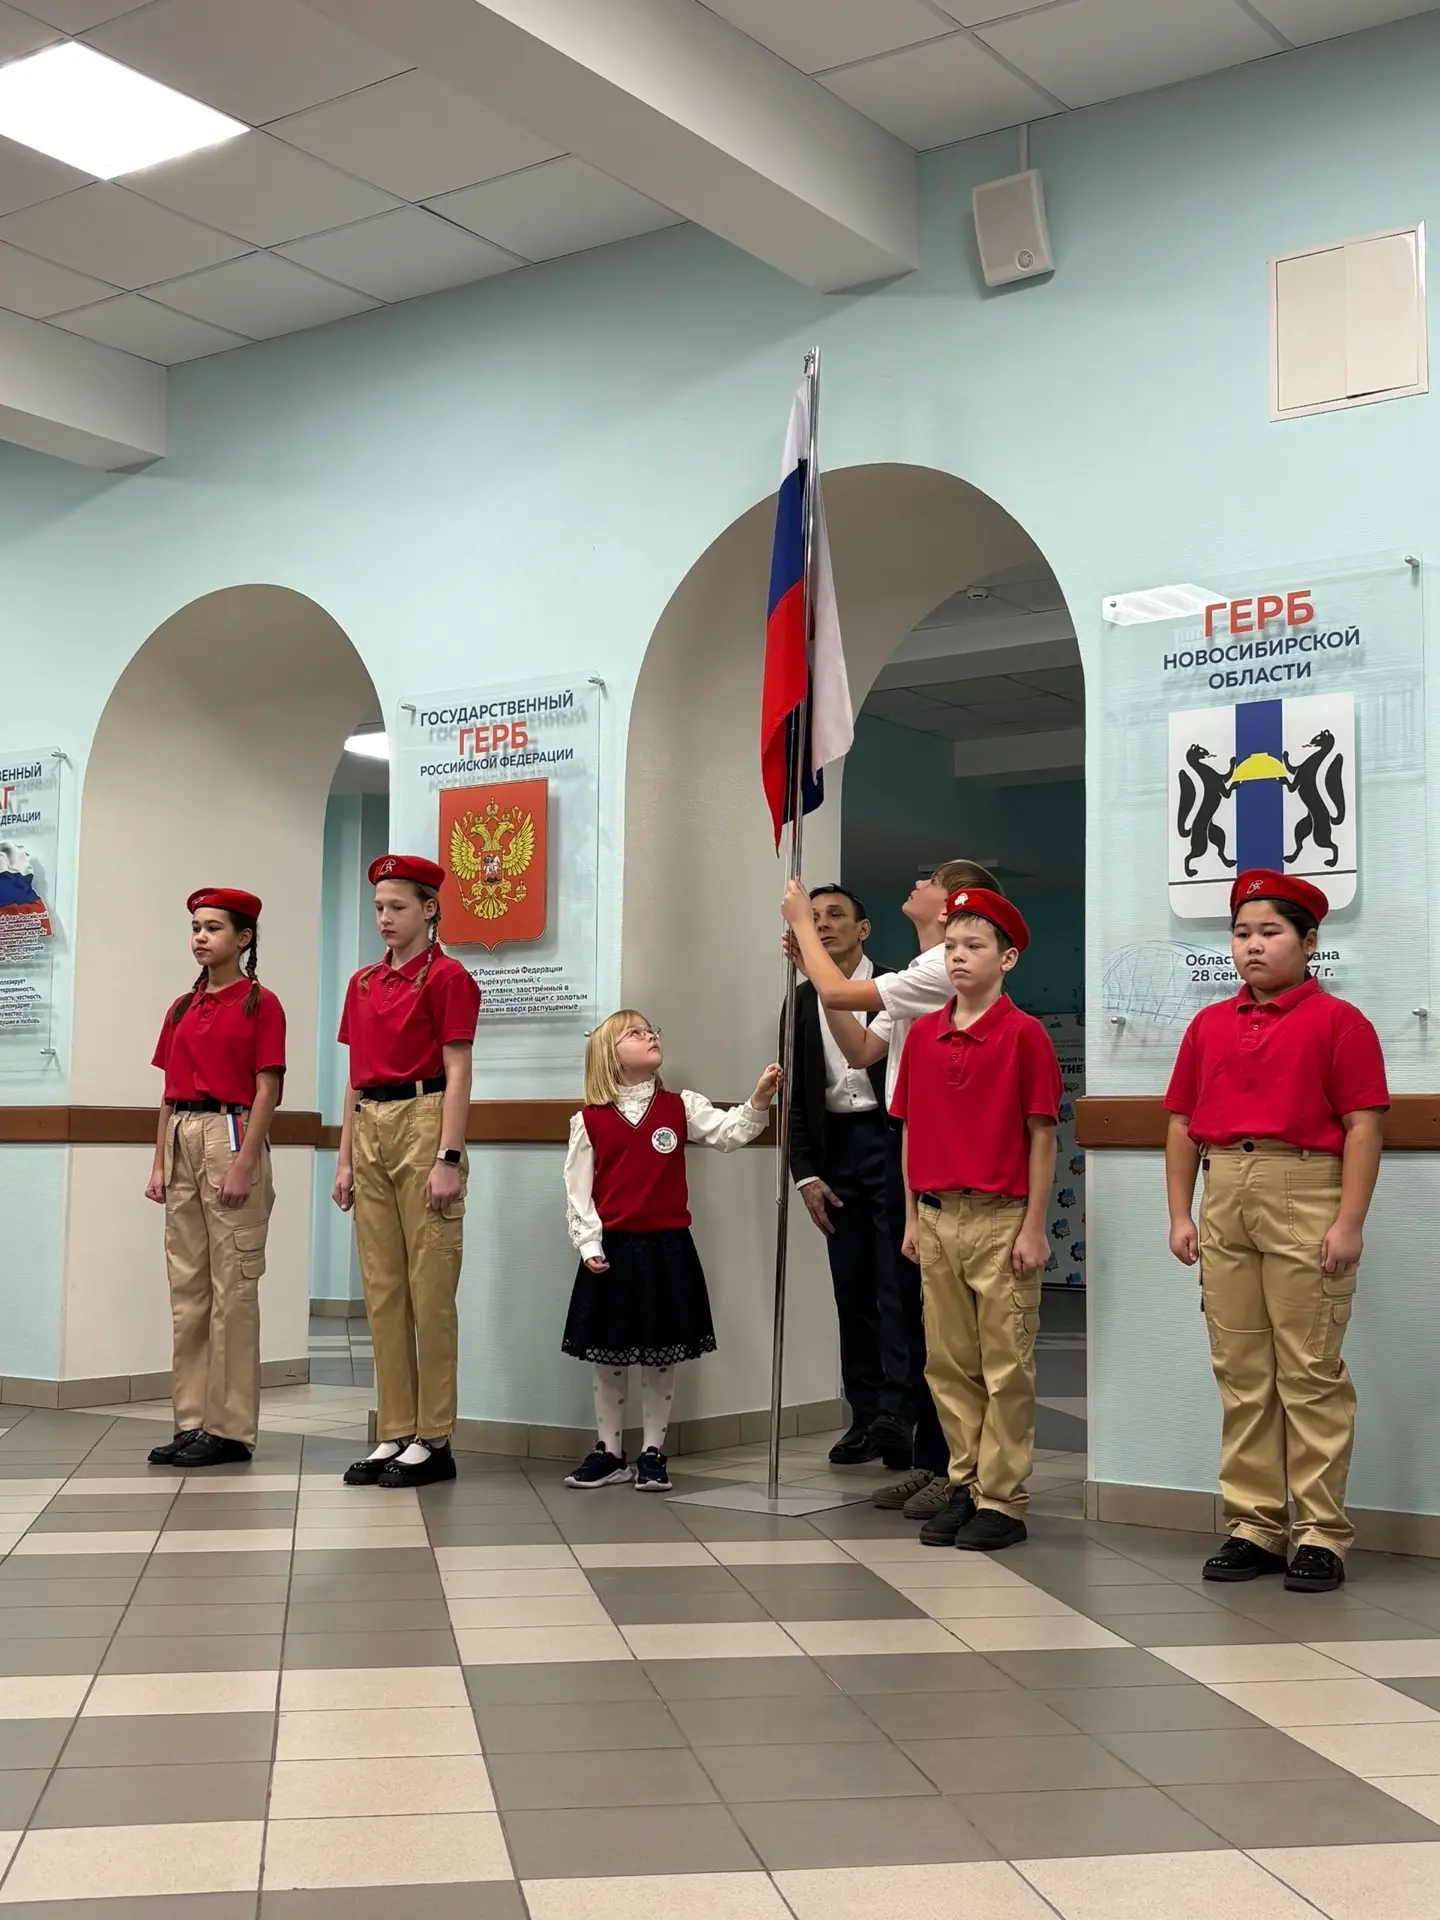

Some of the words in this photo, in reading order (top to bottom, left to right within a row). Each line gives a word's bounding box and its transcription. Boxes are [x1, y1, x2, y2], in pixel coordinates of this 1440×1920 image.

[1205, 590, 1314, 637] ГЕРБ
[1164, 626, 1360, 670] НОВОСИБИРСКОЙ
[1208, 662, 1312, 690] ОБЛАСТИ
[421, 690, 574, 726] ГОСУДАРСТВЕННЫЙ
[458, 721, 529, 755] ГЕРБ
[420, 755, 498, 776] РОССИЙСКОЙ
[499, 749, 574, 768] ФЕДЕРАЦИИ
[480, 966, 520, 976] Российской
[521, 965, 563, 975] Федерации
[1186, 953, 1233, 966] Облас
[1311, 950, 1340, 961] ана
[1191, 970, 1210, 981] 28
[1213, 971, 1243, 981] сен
[1324, 967, 1334, 977] г.
